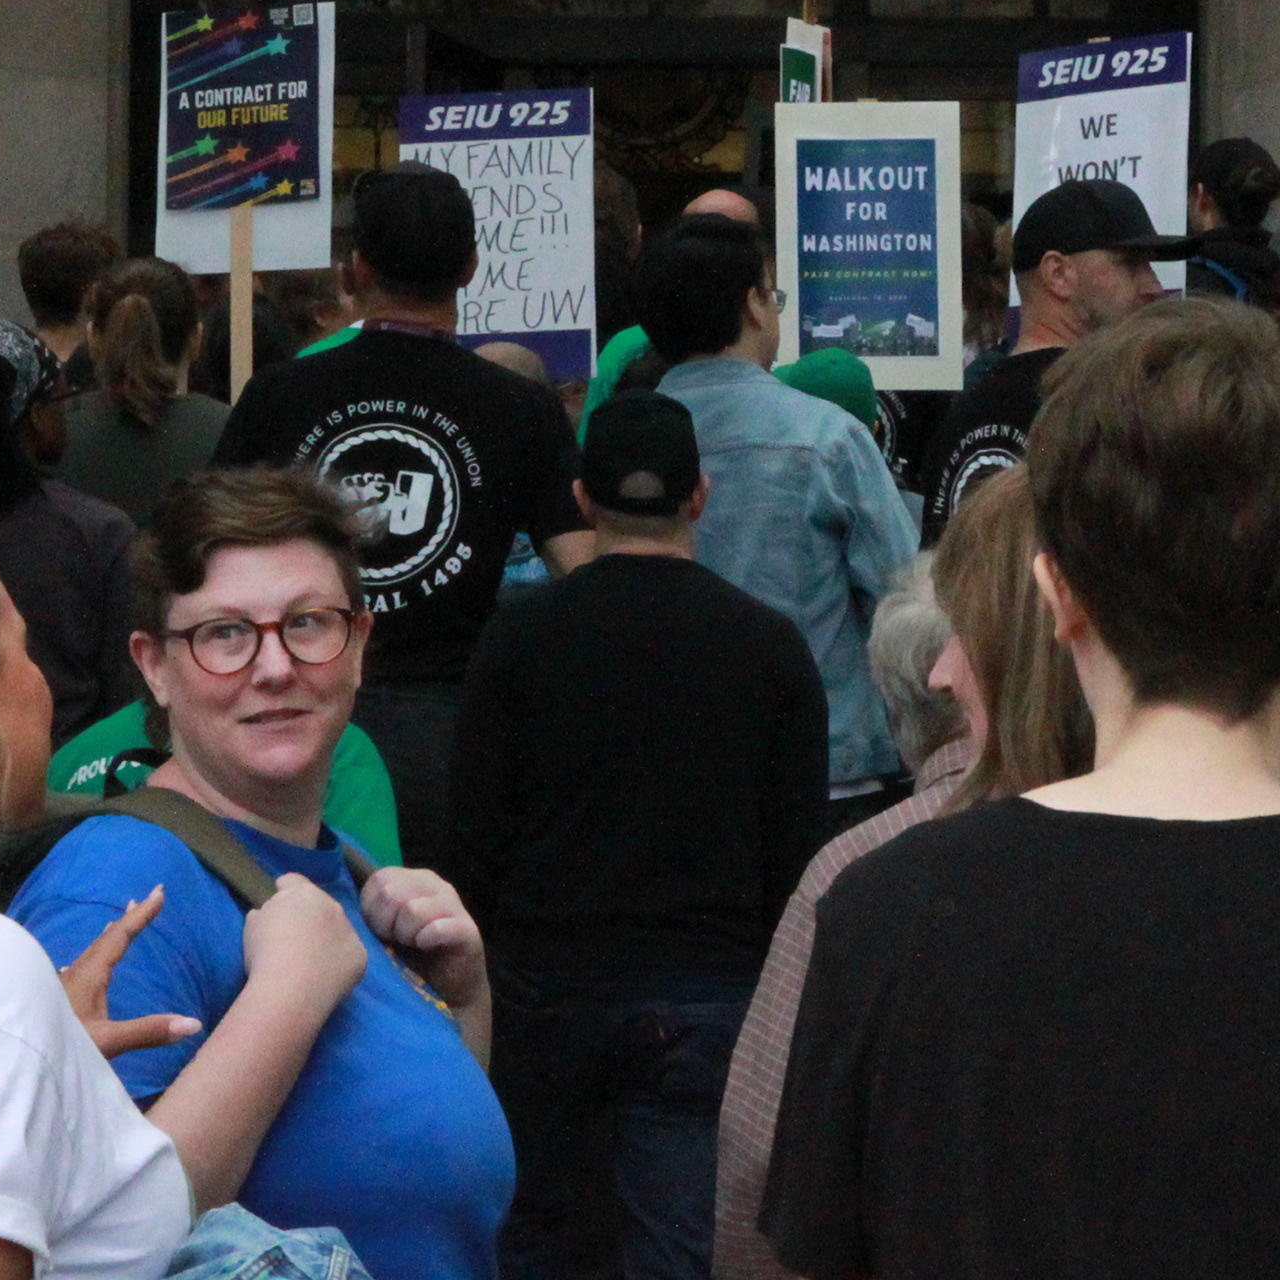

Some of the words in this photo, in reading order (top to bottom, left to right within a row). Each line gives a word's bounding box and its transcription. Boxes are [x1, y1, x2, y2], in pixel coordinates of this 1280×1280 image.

[1038, 54, 1105, 88] SEIU
[1111, 46, 1169, 77] 925
[179, 92, 190, 110] A
[195, 84, 273, 108] CONTRACT
[277, 80, 308, 100] FOR
[197, 109, 226, 129] OUR
[231, 103, 289, 125] FUTURE
[425, 103, 503, 131] SEIU
[509, 101, 572, 127] 925
[1080, 113, 1118, 140] WE
[466, 139, 586, 180] FAMILY
[804, 166, 929, 192] WALKOUT
[845, 202, 887, 221] FOR
[802, 234, 933, 253] WASHINGTON
[478, 257, 536, 297] ME
[523, 285, 587, 329] UW
[294, 425, 325, 464] HERE
[326, 410, 343, 426] IS
[347, 400, 407, 417] POWER
[412, 404, 430, 419] IN
[432, 412, 460, 437] THE
[455, 435, 483, 488] UNION
[960, 424, 998, 450] POWER
[1000, 424, 1011, 437] IN
[420, 542, 472, 596] 1495
